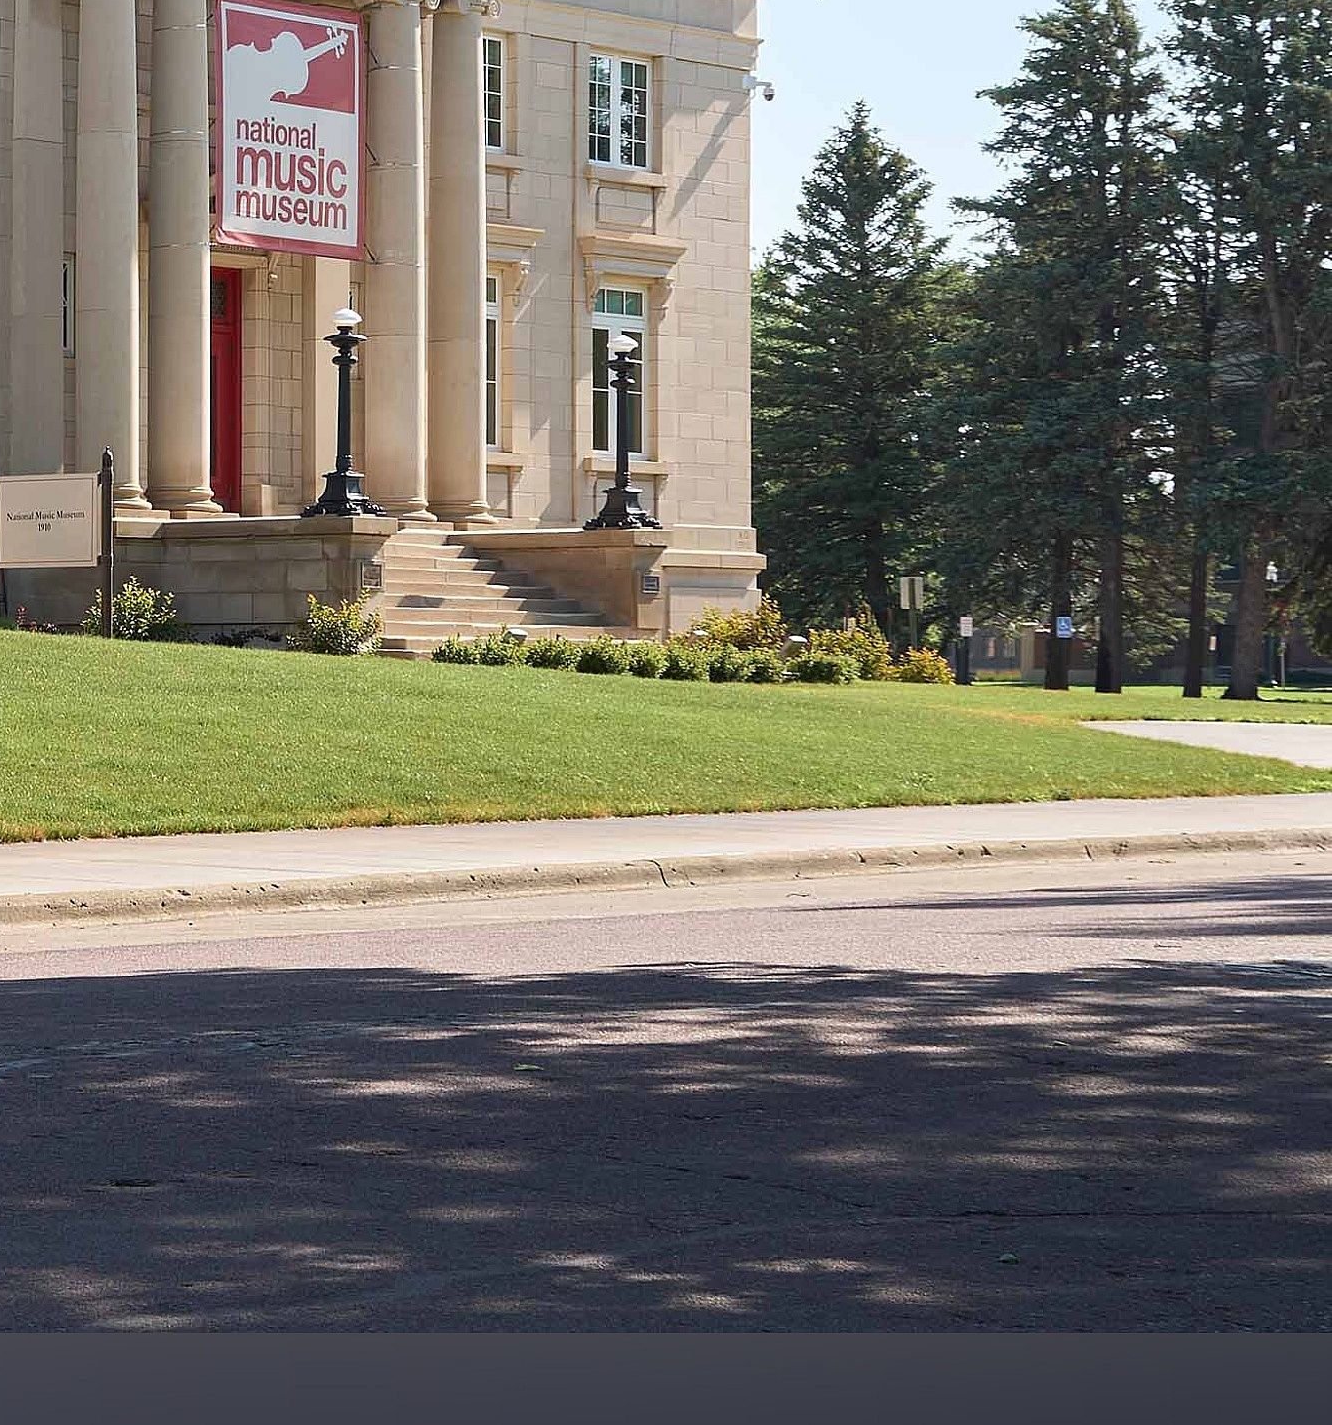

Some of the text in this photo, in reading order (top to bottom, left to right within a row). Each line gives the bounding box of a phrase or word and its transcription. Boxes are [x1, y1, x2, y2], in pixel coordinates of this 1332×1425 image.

[236, 116, 316, 150] national
[236, 146, 347, 198] music
[235, 190, 348, 230] museum
[6, 511, 34, 521] National
[35, 511, 56, 520] Music
